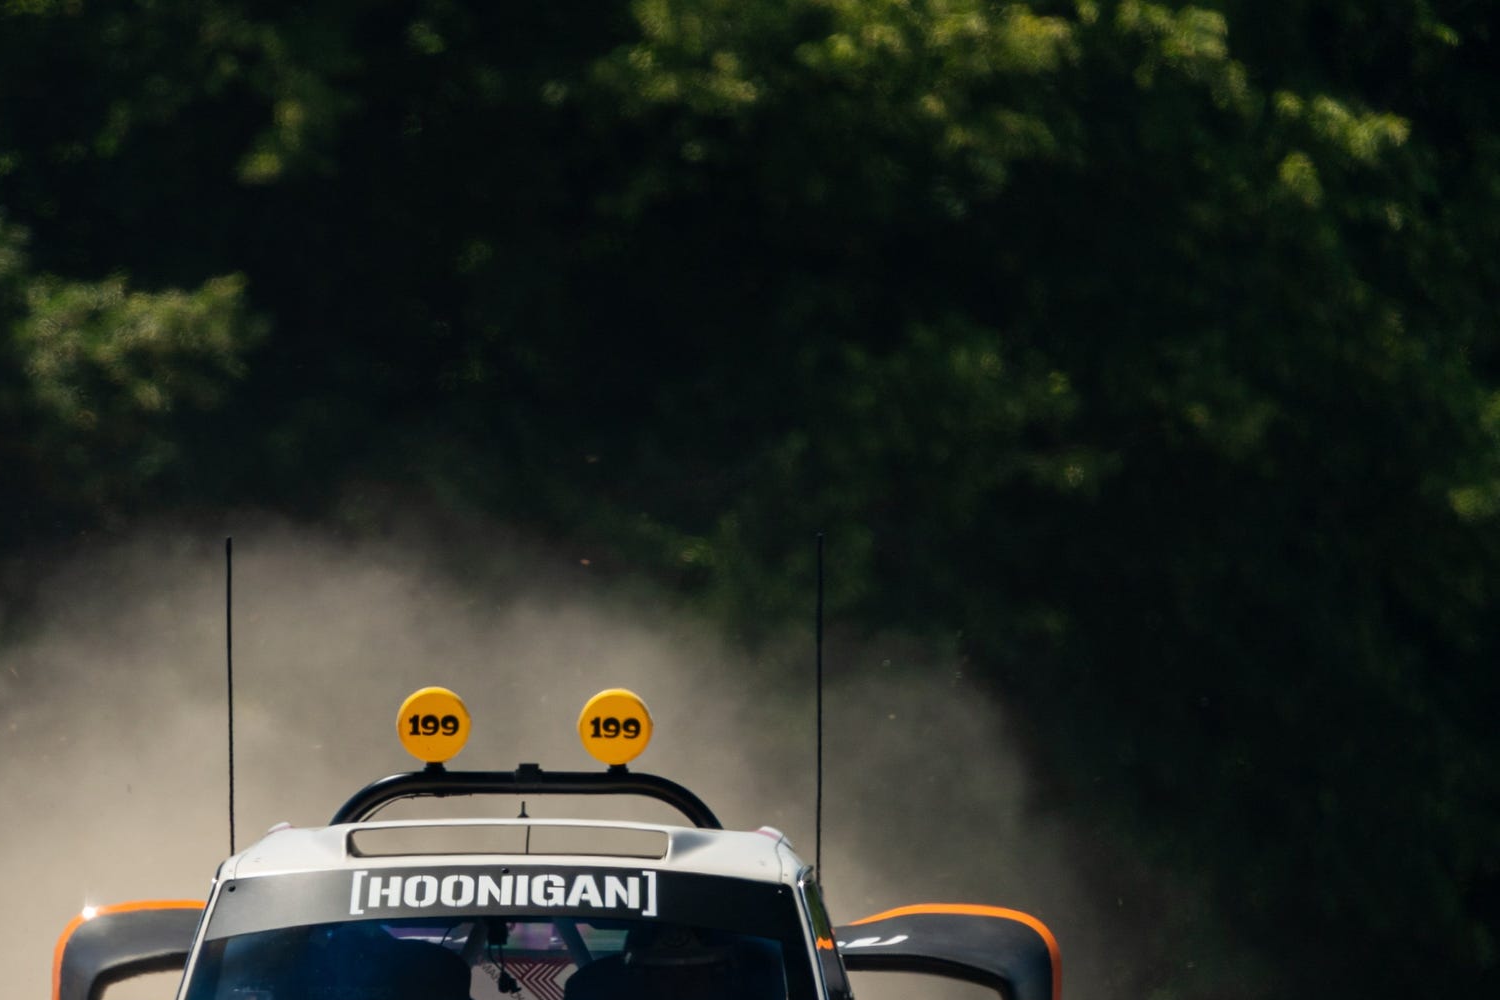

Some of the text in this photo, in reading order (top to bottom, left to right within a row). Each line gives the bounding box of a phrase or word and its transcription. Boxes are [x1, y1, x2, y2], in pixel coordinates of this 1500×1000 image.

[408, 714, 460, 737] 199
[590, 717, 642, 739] 199
[349, 870, 658, 917] [HOONIGAN]
